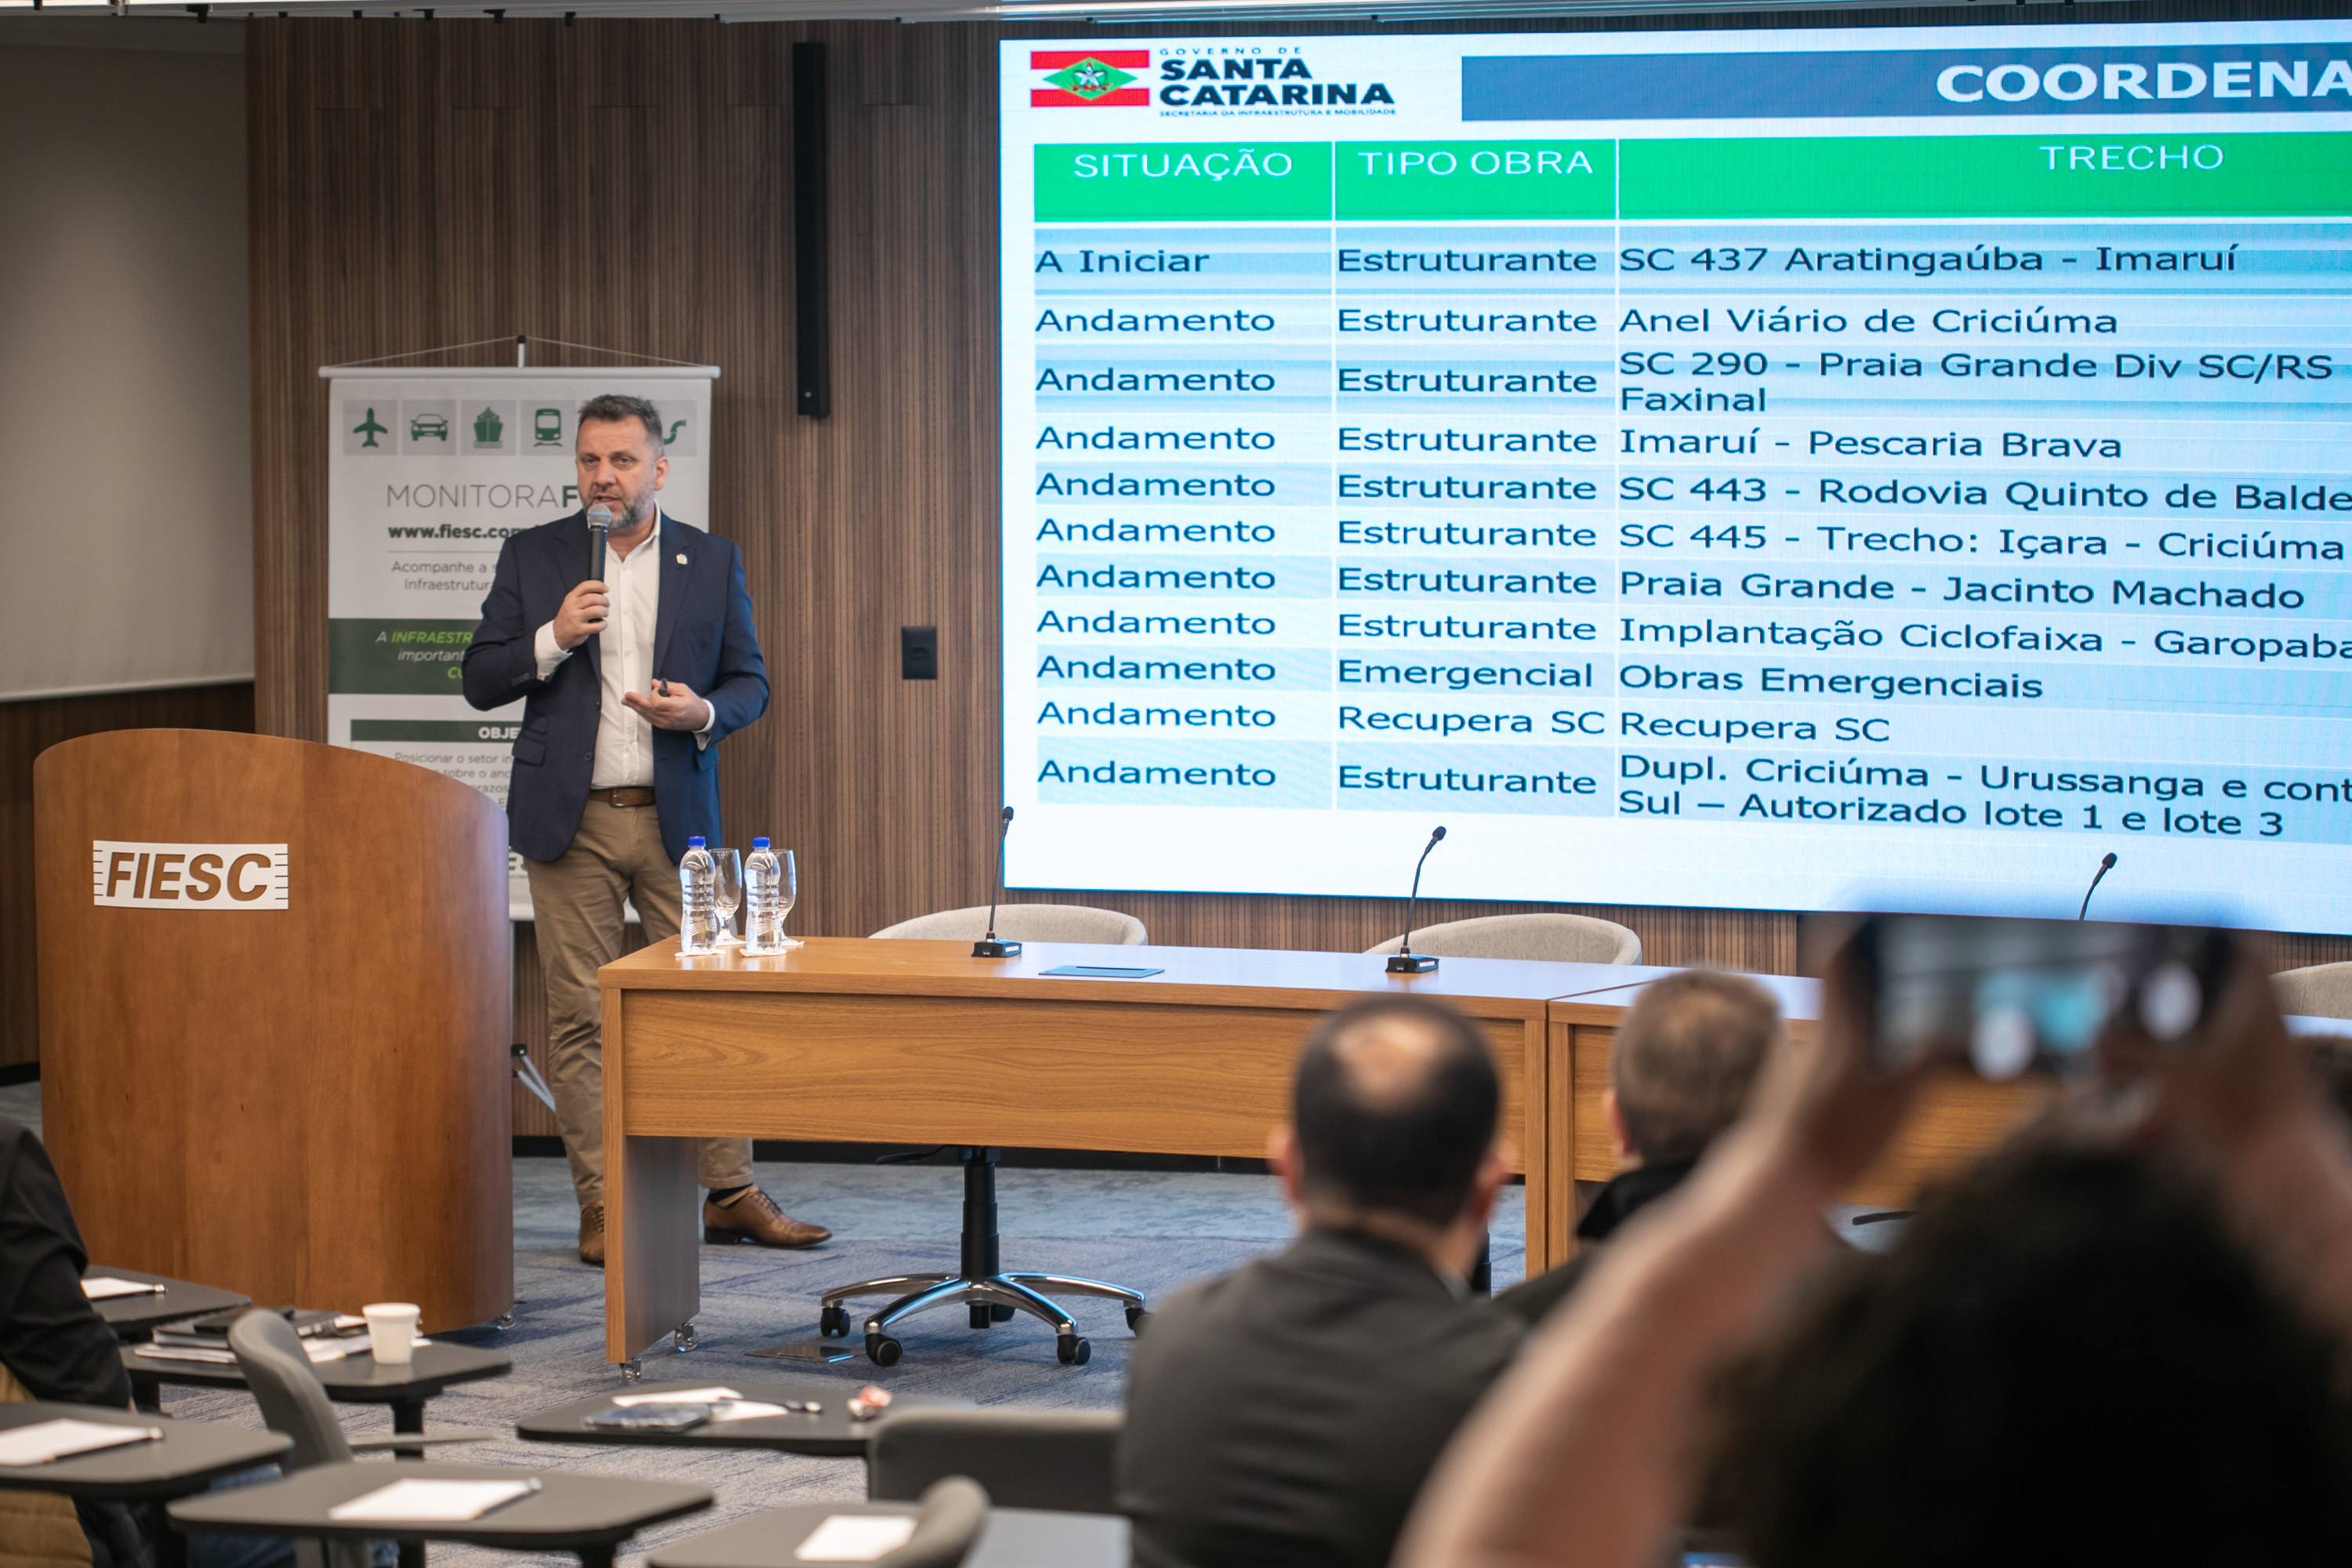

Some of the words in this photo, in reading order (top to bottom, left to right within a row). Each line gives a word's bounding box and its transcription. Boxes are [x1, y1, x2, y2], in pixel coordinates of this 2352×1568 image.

[1160, 47, 1261, 56] GOVERNO
[1160, 58, 1312, 82] SANTA
[1936, 60, 2352, 103] COORDENA
[1160, 83, 1395, 107] CATARINA
[1075, 148, 1292, 181] SITUAÇÃO
[1358, 151, 1457, 175] TIPO
[1471, 151, 1593, 175] OBRA
[2040, 145, 2223, 170] TRECHO
[1035, 250, 1063, 273] A
[1080, 249, 1210, 273] Iniciar
[1338, 249, 1597, 272] Estruturante
[1621, 248, 1675, 271] SC
[1690, 248, 1768, 271] 437
[1784, 244, 2043, 277] Aratingaúba
[2096, 243, 2239, 271] Imaruí
[1035, 308, 1275, 332] Andamento
[1338, 309, 1597, 332] Estruturante
[1619, 308, 1709, 332] Anel
[1726, 305, 1847, 332] Viário
[1864, 308, 1915, 332] de
[1933, 305, 2117, 334] Criciúma
[1035, 367, 1276, 391] Andamento
[1338, 368, 1597, 393] Estruturante
[1621, 351, 1675, 376] SC
[1692, 352, 1768, 376] 290
[1820, 352, 1922, 377] Praia
[1940, 352, 2097, 378] Grande
[2116, 354, 2182, 379] Div
[2198, 354, 2333, 384] SC/RS
[1621, 387, 1766, 412] Faxinal
[1036, 426, 1276, 450] Andamento
[1339, 427, 1597, 452] Estruturante
[1621, 426, 1761, 454] Imaruí
[1809, 430, 1982, 456] Pescaria
[2002, 432, 2122, 458] Brava
[1036, 472, 1276, 496] Andamento
[1338, 474, 1597, 500] Estruturante
[1620, 477, 1674, 501] SC
[1690, 477, 1766, 502] 443
[1820, 478, 1987, 505] Rodovia
[2005, 481, 2149, 512] Quinto
[2165, 483, 2217, 509] de
[2236, 485, 2352, 511] Balde
[1036, 518, 1276, 543] Andamento
[1339, 521, 1596, 546] Estruturante
[1620, 524, 1674, 548] SC
[1690, 524, 1766, 549] 445
[1817, 526, 1977, 553] Trecho:
[1999, 529, 2107, 560] Içara
[2158, 531, 2343, 561] Criciúma
[391, 561, 474, 575] Acompanhe
[478, 564, 486, 572] a
[1036, 564, 1276, 590] Andamento
[1339, 567, 1597, 594] Estruturante
[405, 579, 492, 590] Infraestrutur
[1621, 571, 1722, 597] Praia
[1740, 573, 1894, 600] Grande
[1943, 576, 2094, 604] Jacinto
[2113, 579, 2304, 609] Machado
[1036, 610, 1276, 635] Andamento
[1339, 614, 1596, 641] Estruturante
[1621, 618, 1883, 651] Implantação
[1900, 624, 2103, 652] Ciclofaixa
[376, 631, 387, 643] A
[1036, 655, 1276, 681] Andamento
[1339, 659, 1592, 690] Emergencial
[1620, 664, 1744, 691] Obras
[1762, 667, 2043, 700] Emergenciais
[1037, 702, 1276, 728] Andamento
[1339, 706, 1532, 737] Recupera
[1552, 710, 1605, 735] SC
[1621, 712, 1817, 744] Recupera
[1835, 717, 1889, 742] SC
[478, 727, 521, 739] OBJE
[468, 753, 497, 764] setor
[1037, 760, 1276, 786] Andamento
[1339, 765, 1596, 794] Estruturante
[1621, 754, 1726, 786] Dupl.
[1746, 757, 1929, 787] Criciúma
[1981, 764, 2204, 802] Urussanga
[2222, 779, 2247, 798] e
[1620, 789, 1680, 815] Sul
[1739, 793, 1967, 824] Autorizado
[1985, 800, 2063, 827] lote
[2083, 804, 2103, 829] 1
[2122, 811, 2147, 831] e
[2164, 807, 2241, 835] lote
[2259, 811, 2283, 837] 3
[106, 851, 271, 902] FIESC
